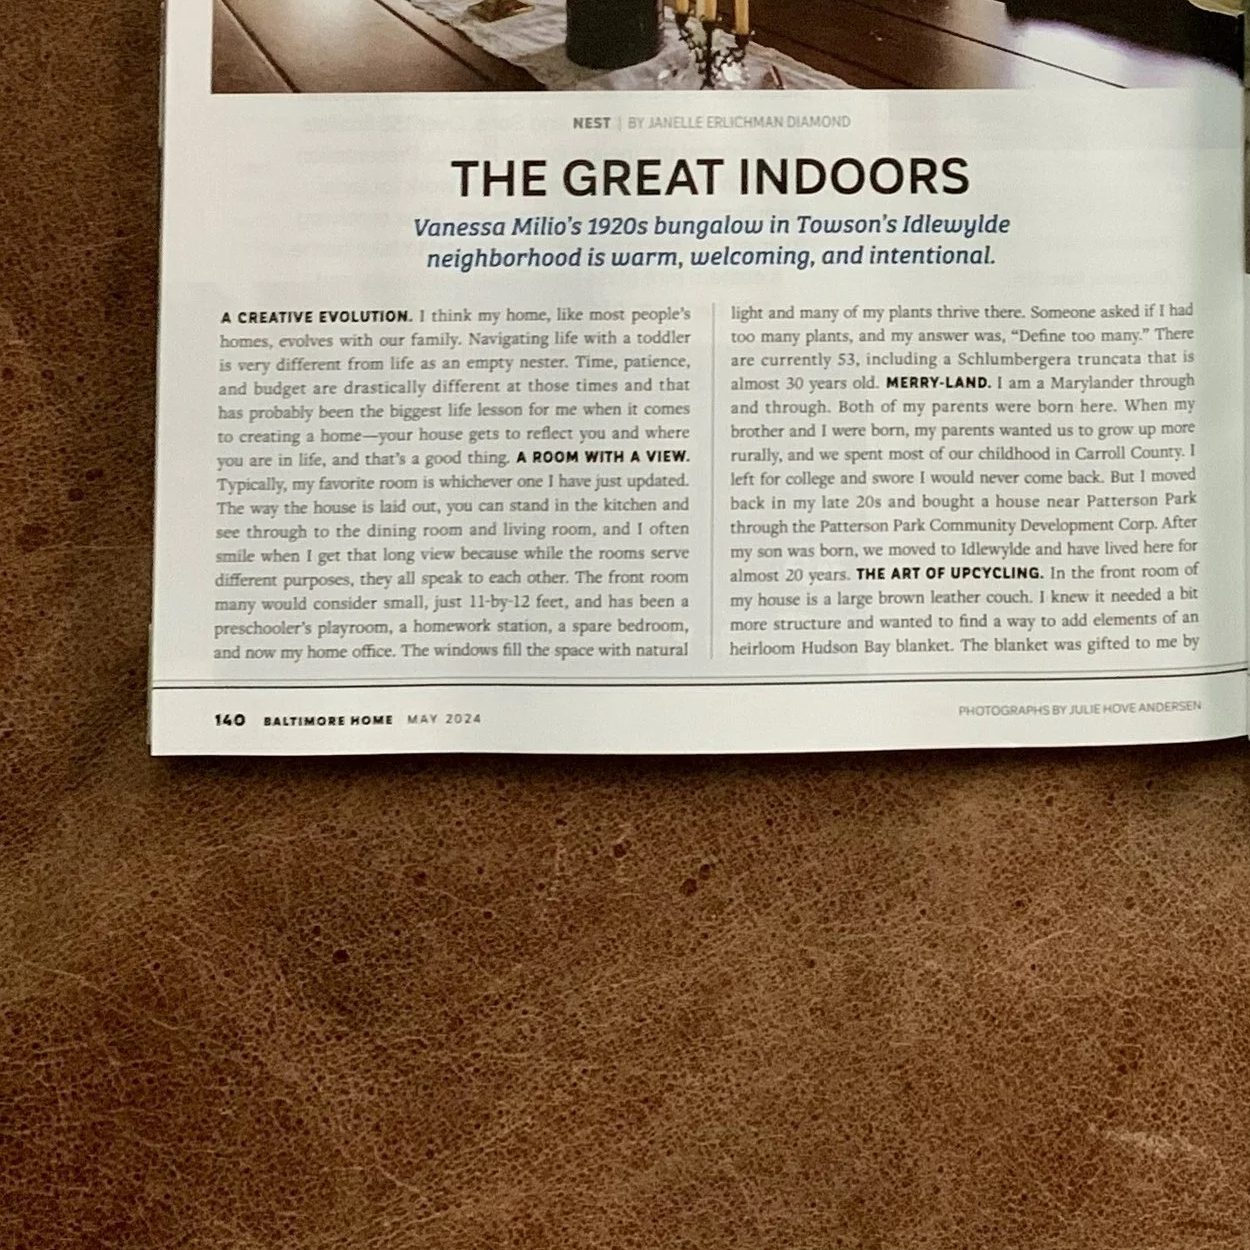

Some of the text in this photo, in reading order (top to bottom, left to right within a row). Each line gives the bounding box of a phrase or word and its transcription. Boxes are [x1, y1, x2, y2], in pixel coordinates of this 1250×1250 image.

[572, 114, 851, 129] NEST BY JANELLE ERLICHMAN DIAMOND
[450, 157, 969, 196] THE GREAT INDOORS
[413, 213, 1010, 239] Vanessa Milio’s 1920s bungalow in Towson’s Idlewylde
[426, 245, 995, 272] neighborhood is warm, welcoming, and intentional.
[220, 306, 690, 325] A CREATIVE EVOLUTION. I think my home, like most people’s
[218, 377, 690, 398] and budget are drastically different at those times and that
[730, 373, 1195, 393] almost 30 years old. MERRY-LAND. I am a Marylander through
[216, 449, 690, 470] you are in life, and that’s a good thing. A ROOM WITH A VIEW.
[730, 490, 1197, 513] back in my late 20s and bought a house near Patterson Park
[729, 514, 1198, 537] through the Patterson Park Community Development Corp. After
[730, 561, 1199, 585] almost 20 years. THE ART OF UPCYCLING. In the front room of
[958, 700, 1202, 716] PHOTOGRAPHS BY JULIE HOVE ANDERSEN
[214, 713, 480, 726] 140 BALTIMORE HOME MAY 2024
